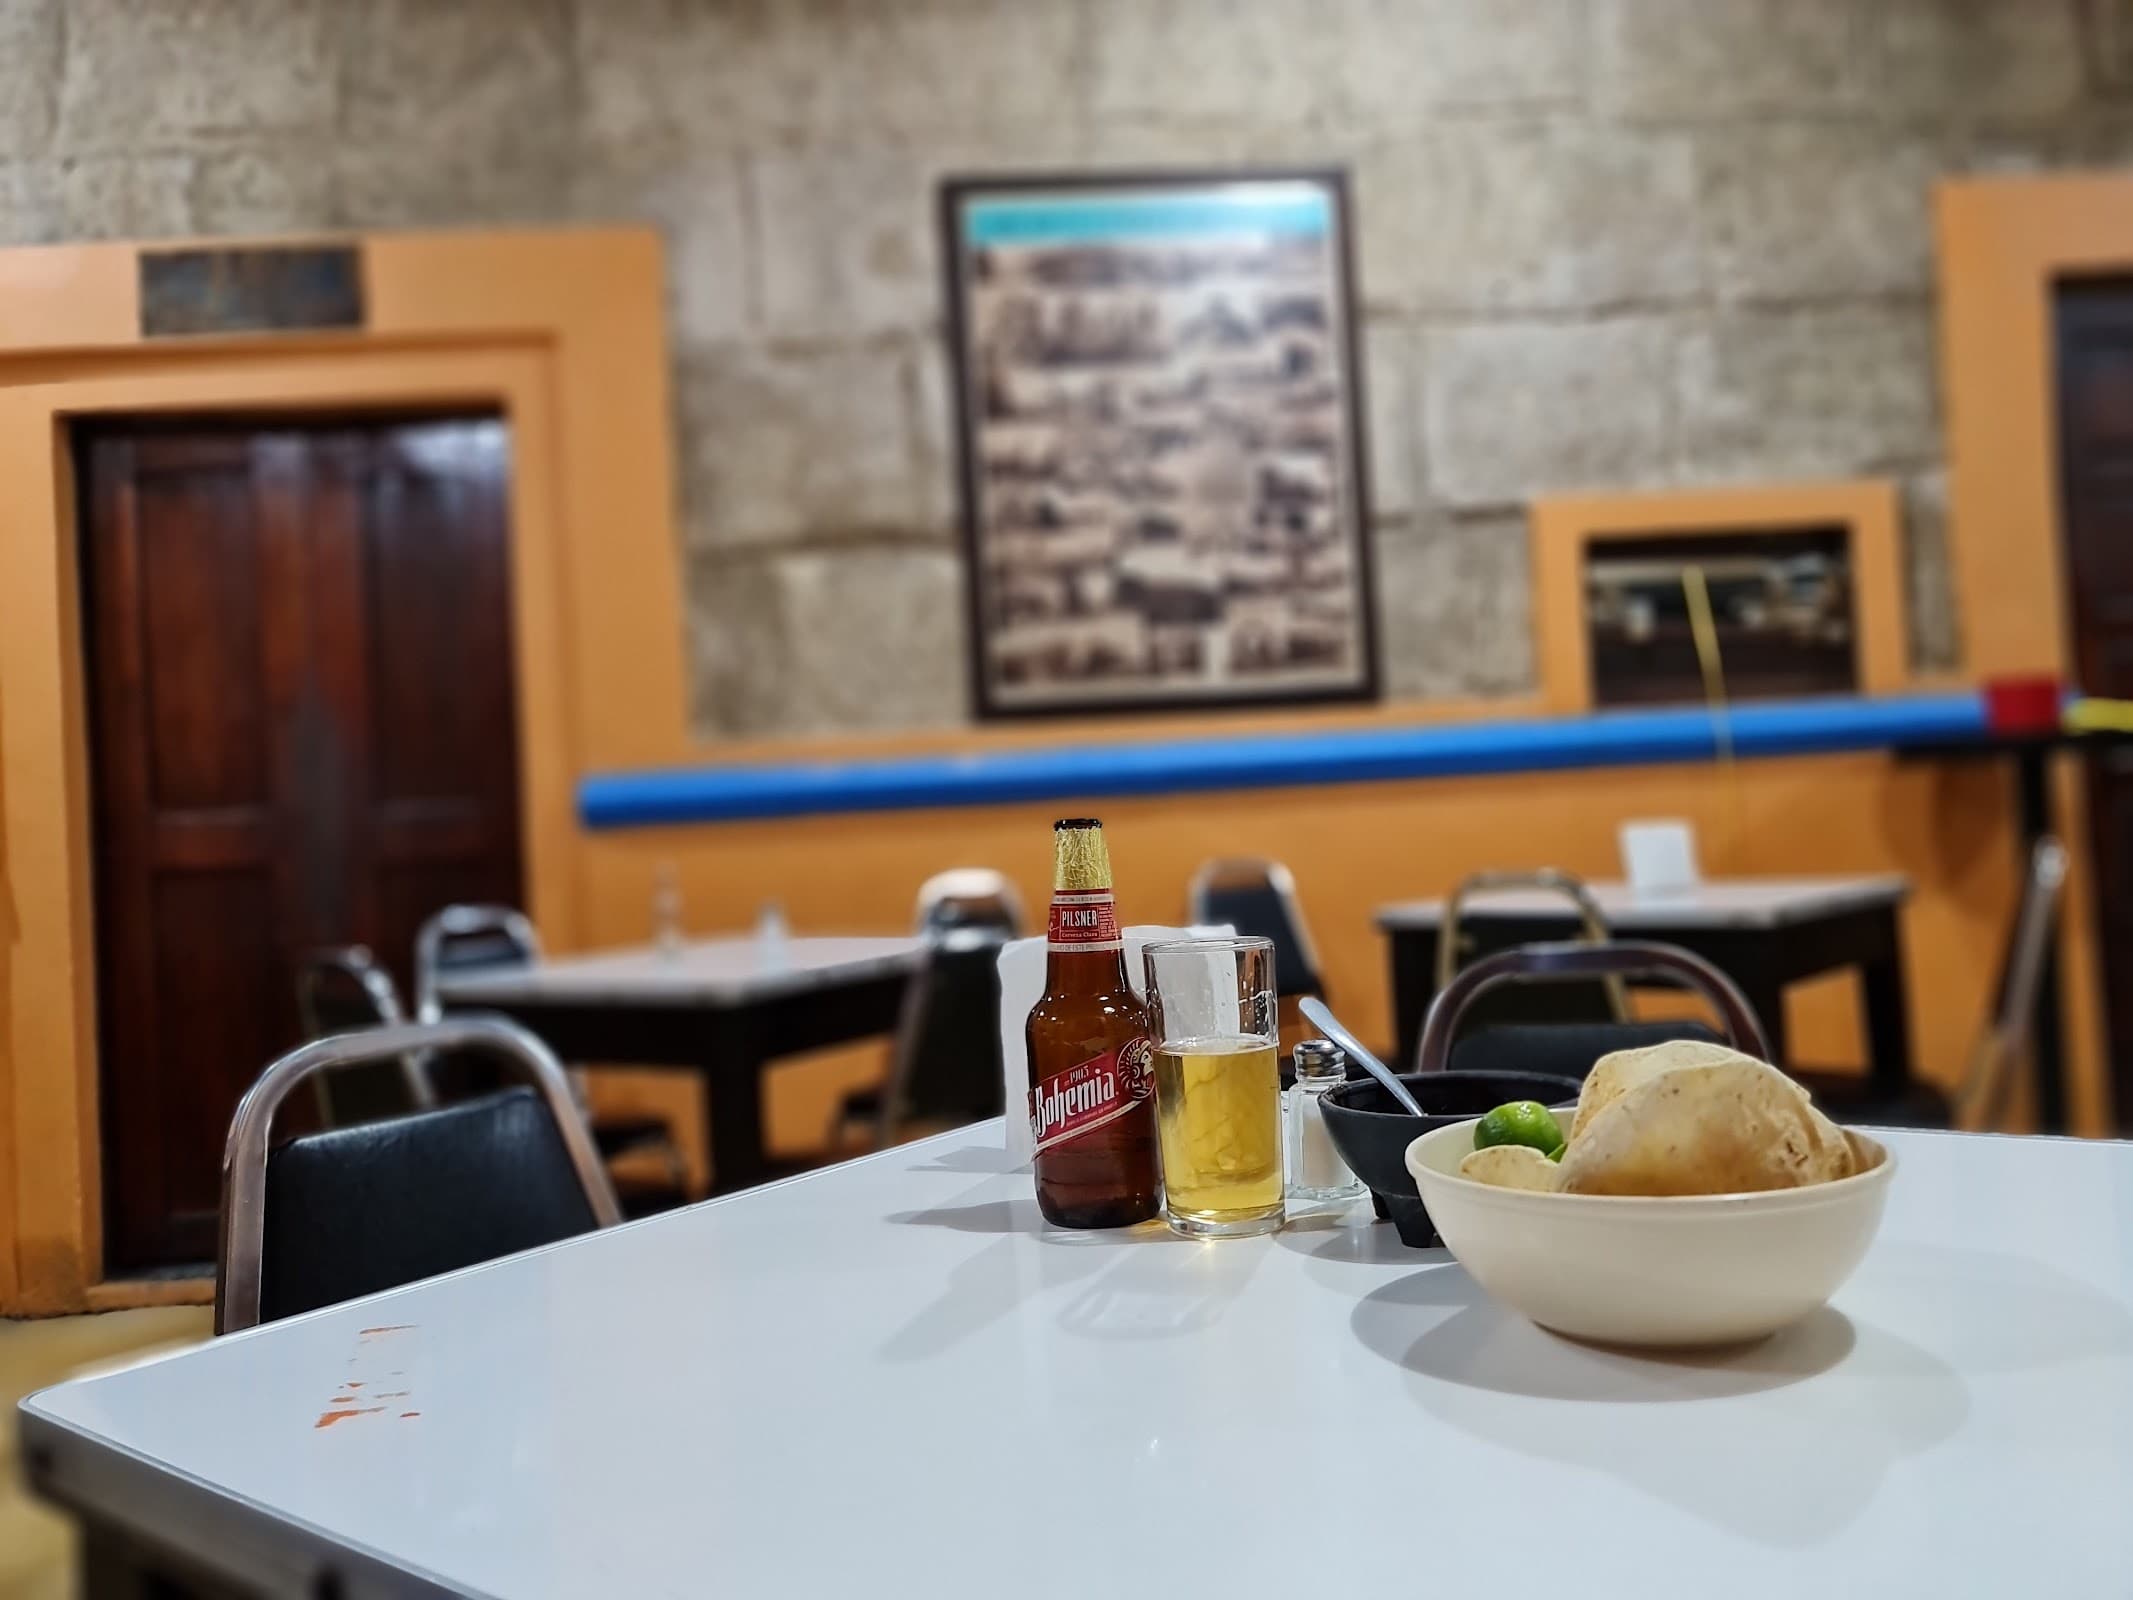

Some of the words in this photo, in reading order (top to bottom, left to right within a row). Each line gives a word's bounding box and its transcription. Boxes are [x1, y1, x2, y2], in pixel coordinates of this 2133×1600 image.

[1062, 910, 1098, 927] PILSNER
[1070, 1065, 1089, 1084] 1905
[1035, 1068, 1115, 1138] Bohemia
